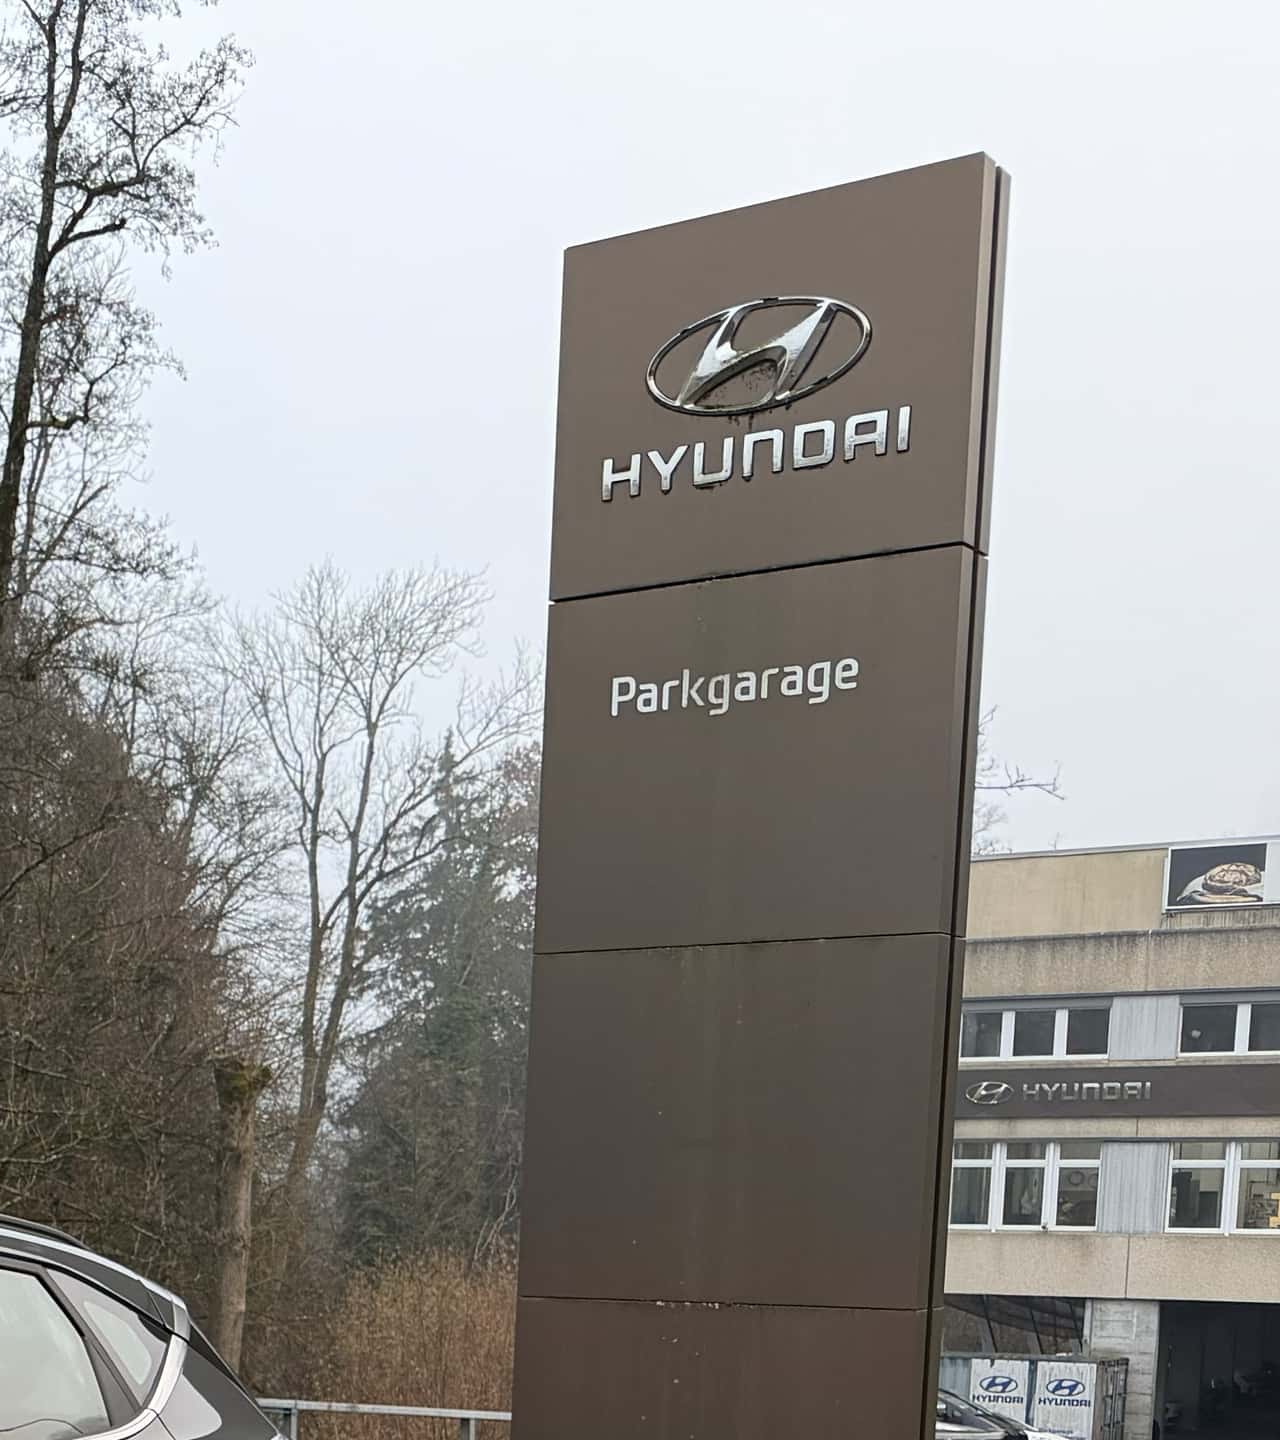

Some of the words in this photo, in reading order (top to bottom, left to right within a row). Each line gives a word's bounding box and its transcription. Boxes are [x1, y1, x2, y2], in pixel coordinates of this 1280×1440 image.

[600, 404, 912, 502] HYUNDAI
[609, 657, 860, 717] Parkgarage
[1022, 1081, 1152, 1101] HYUNDAI
[972, 1394, 1024, 1404] HYUNDAI
[1038, 1397, 1091, 1407] HYUNDAI
